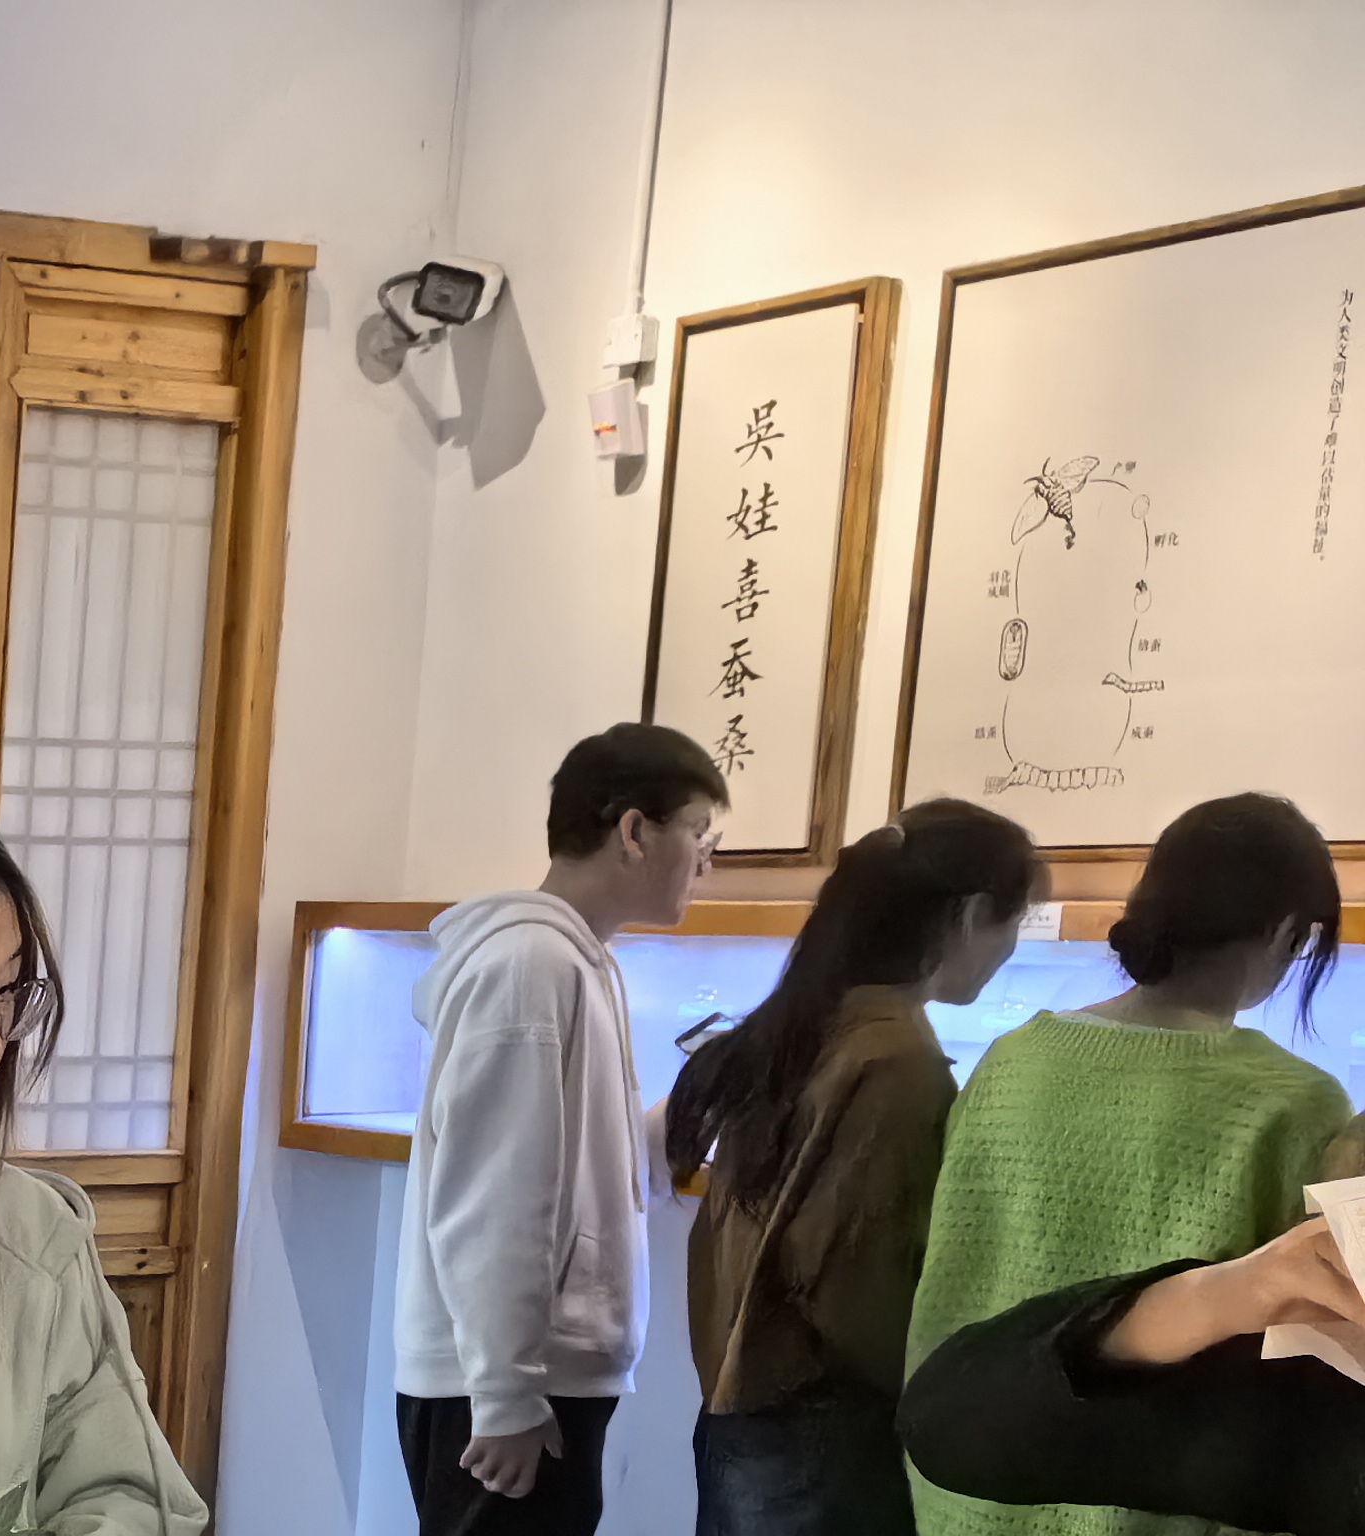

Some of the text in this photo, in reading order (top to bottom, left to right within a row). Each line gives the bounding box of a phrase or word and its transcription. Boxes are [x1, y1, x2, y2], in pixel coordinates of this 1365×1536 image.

[707, 400, 785, 776] 吳娃喜蚕桑
